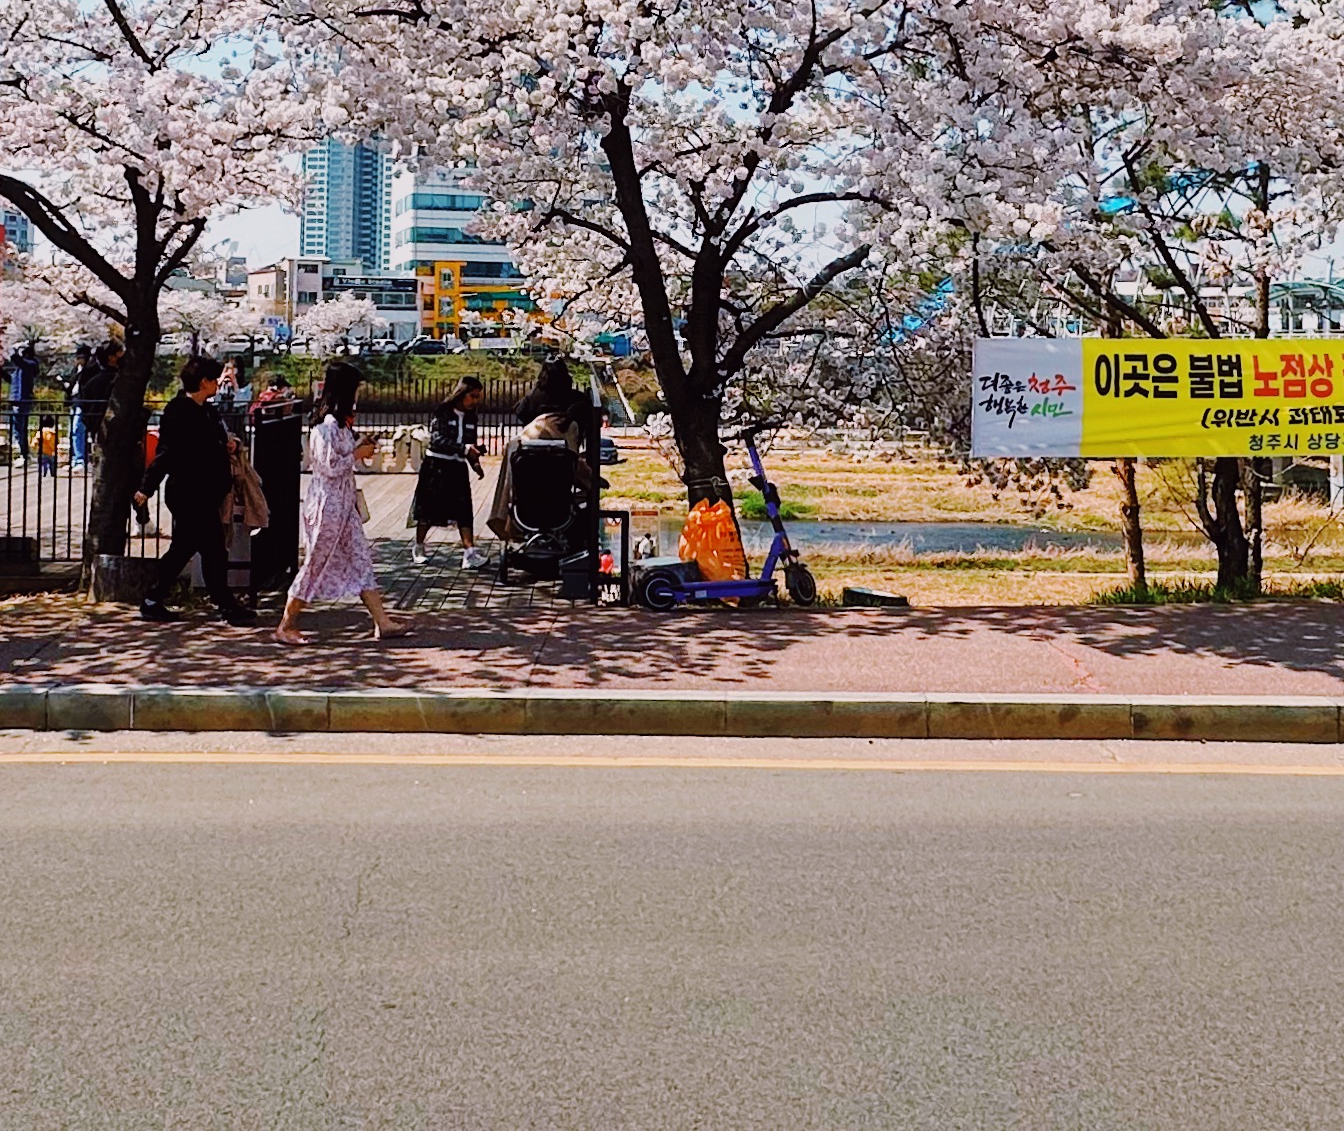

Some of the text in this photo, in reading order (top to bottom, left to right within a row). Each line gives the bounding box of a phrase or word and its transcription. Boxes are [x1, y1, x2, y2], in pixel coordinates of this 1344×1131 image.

[1027, 372, 1076, 397] 청주
[1094, 353, 1179, 399] 이곳은
[1188, 354, 1244, 399] 불법
[1252, 353, 1334, 399] 노점상
[978, 393, 1073, 429] 행복한 시민
[1200, 407, 1281, 429] (위반시
[1248, 433, 1299, 451] 청주시
